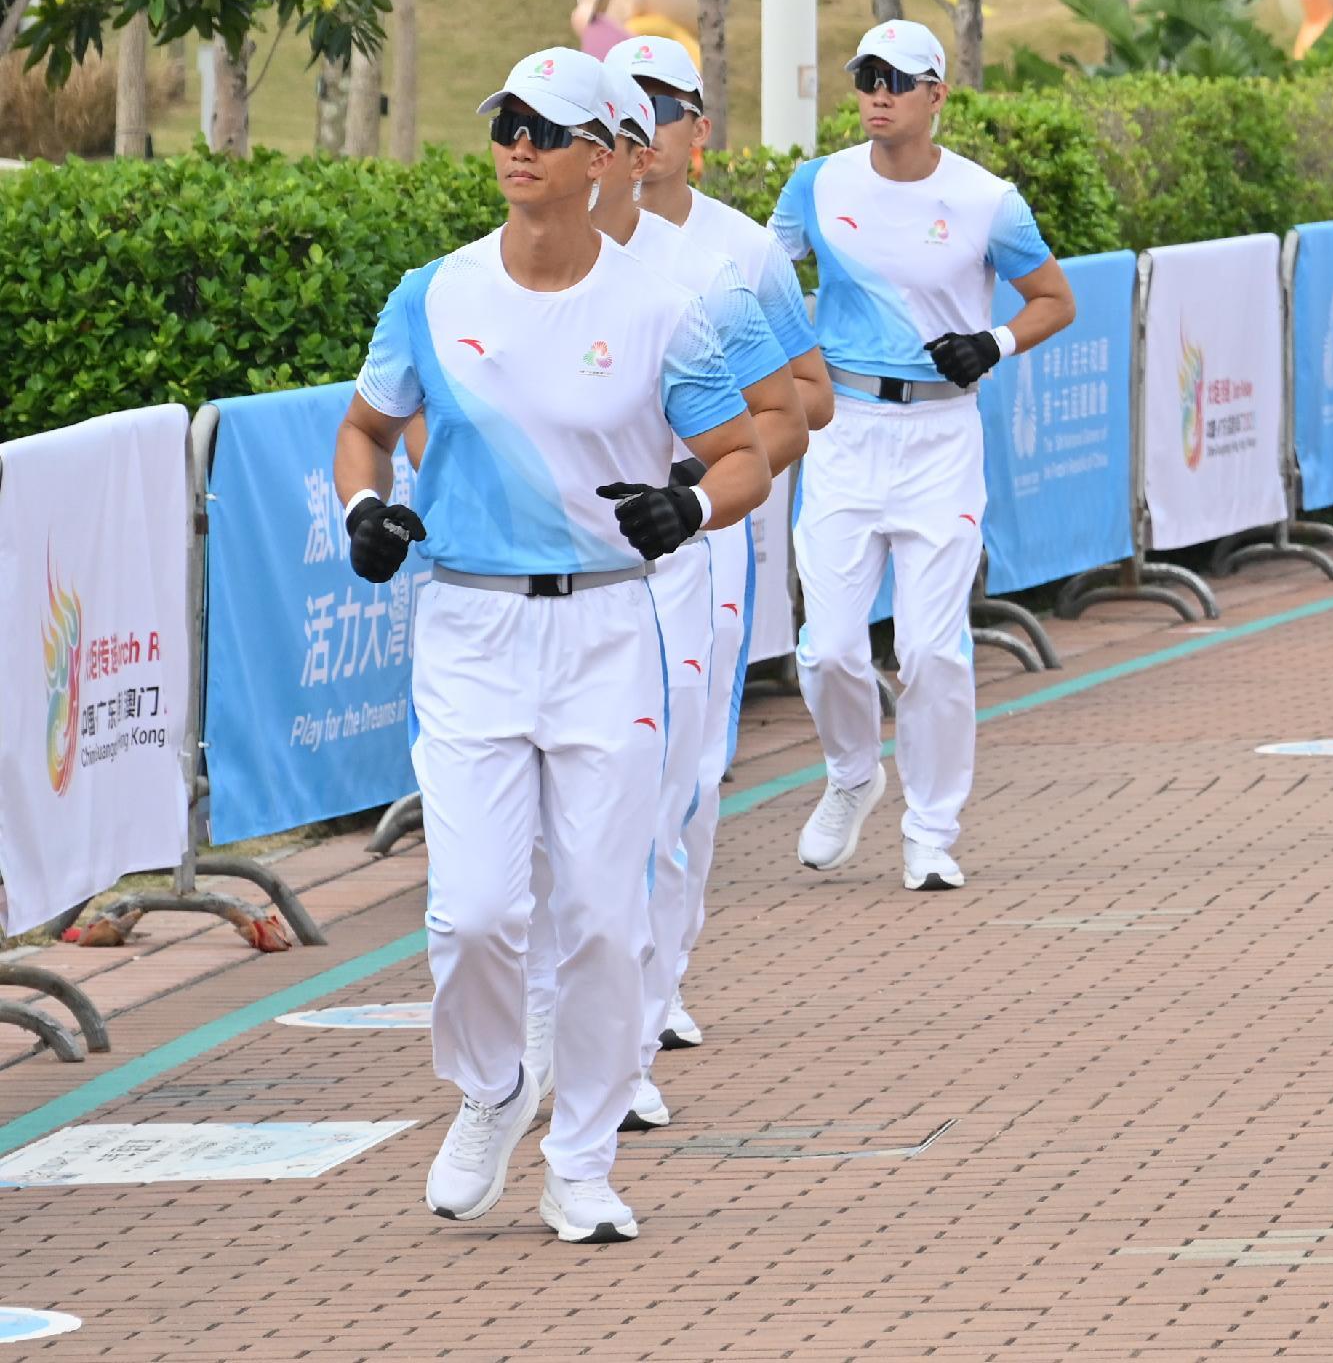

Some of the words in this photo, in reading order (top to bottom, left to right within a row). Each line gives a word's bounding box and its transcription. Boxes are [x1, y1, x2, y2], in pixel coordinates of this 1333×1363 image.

[290, 713, 323, 753] Play
[325, 708, 341, 742] for
[343, 704, 360, 737] the
[361, 702, 396, 733] Dreams
